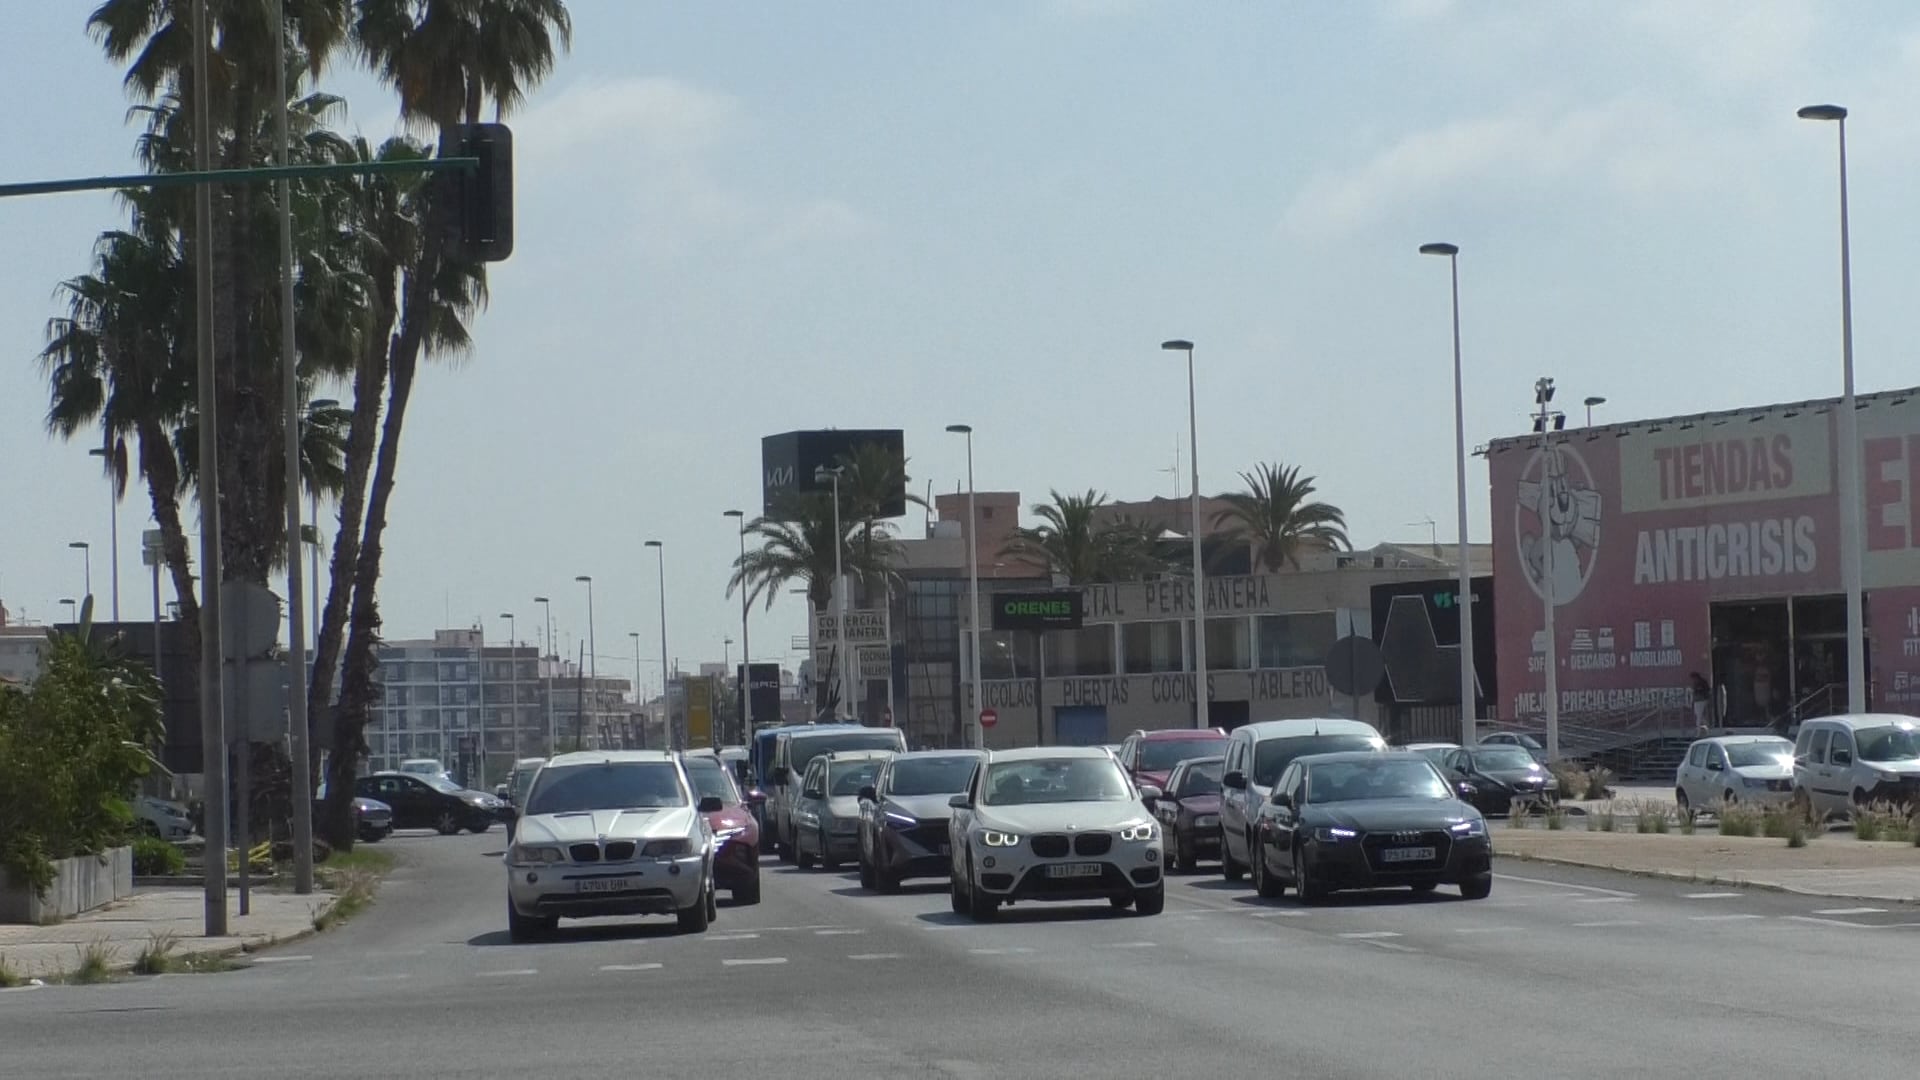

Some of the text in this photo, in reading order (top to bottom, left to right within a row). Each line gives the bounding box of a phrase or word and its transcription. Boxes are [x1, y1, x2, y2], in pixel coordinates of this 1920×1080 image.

[1654, 434, 1793, 500] TIENDAS
[1634, 515, 1816, 584] ANTICRISIS
[1004, 601, 1072, 615] ORENES
[1571, 652, 1616, 670] DESCANSO
[1630, 650, 1682, 666] MOBILIARIO
[1063, 678, 1128, 705] PUERTAS
[1152, 673, 1215, 702] COCINS
[1248, 669, 1329, 699] TABLERO
[1562, 688, 1604, 713] PRECIO
